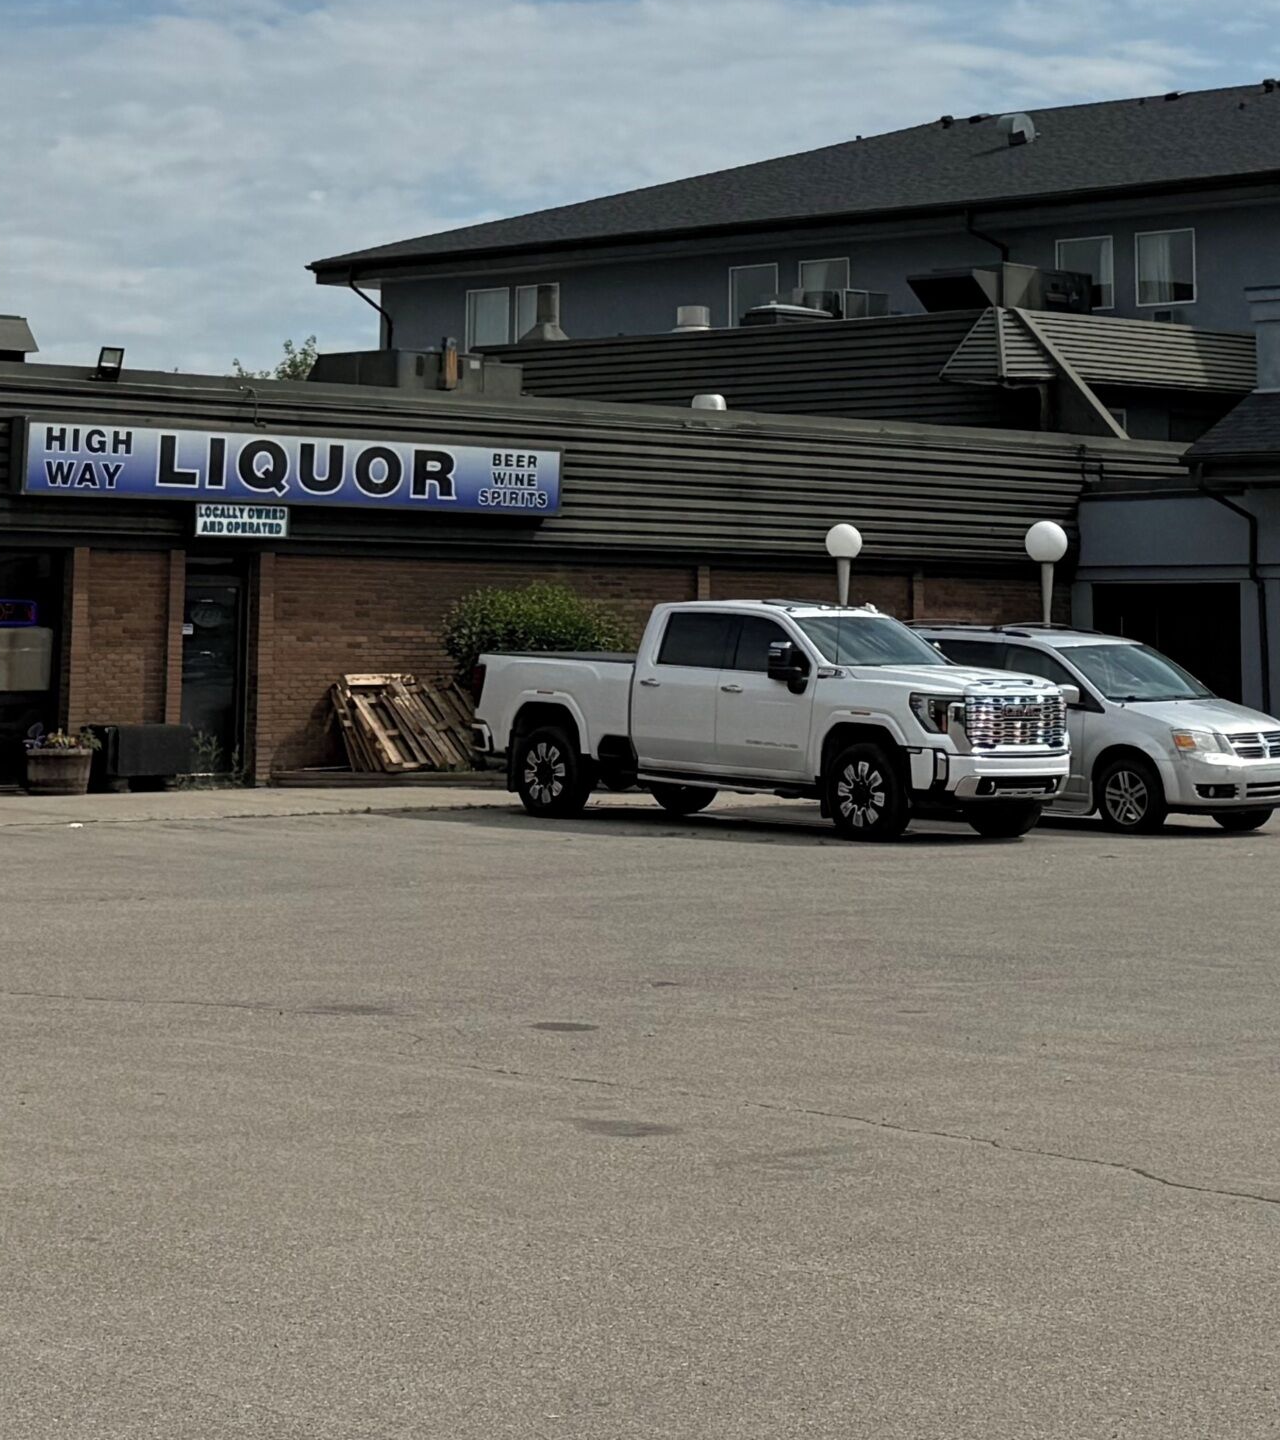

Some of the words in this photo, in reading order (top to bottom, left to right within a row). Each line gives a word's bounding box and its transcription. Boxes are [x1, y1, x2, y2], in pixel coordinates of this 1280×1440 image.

[44, 426, 133, 456] HIGH
[155, 431, 457, 500] LIQUOR
[492, 452, 538, 469] BEER
[44, 459, 125, 489] WAY
[492, 471, 537, 488] WINE
[478, 488, 548, 508] SPIRITS
[198, 505, 246, 519] LOCALLY
[247, 507, 286, 520] OWNED
[201, 520, 224, 533] AND
[226, 521, 282, 534] OPERATED
